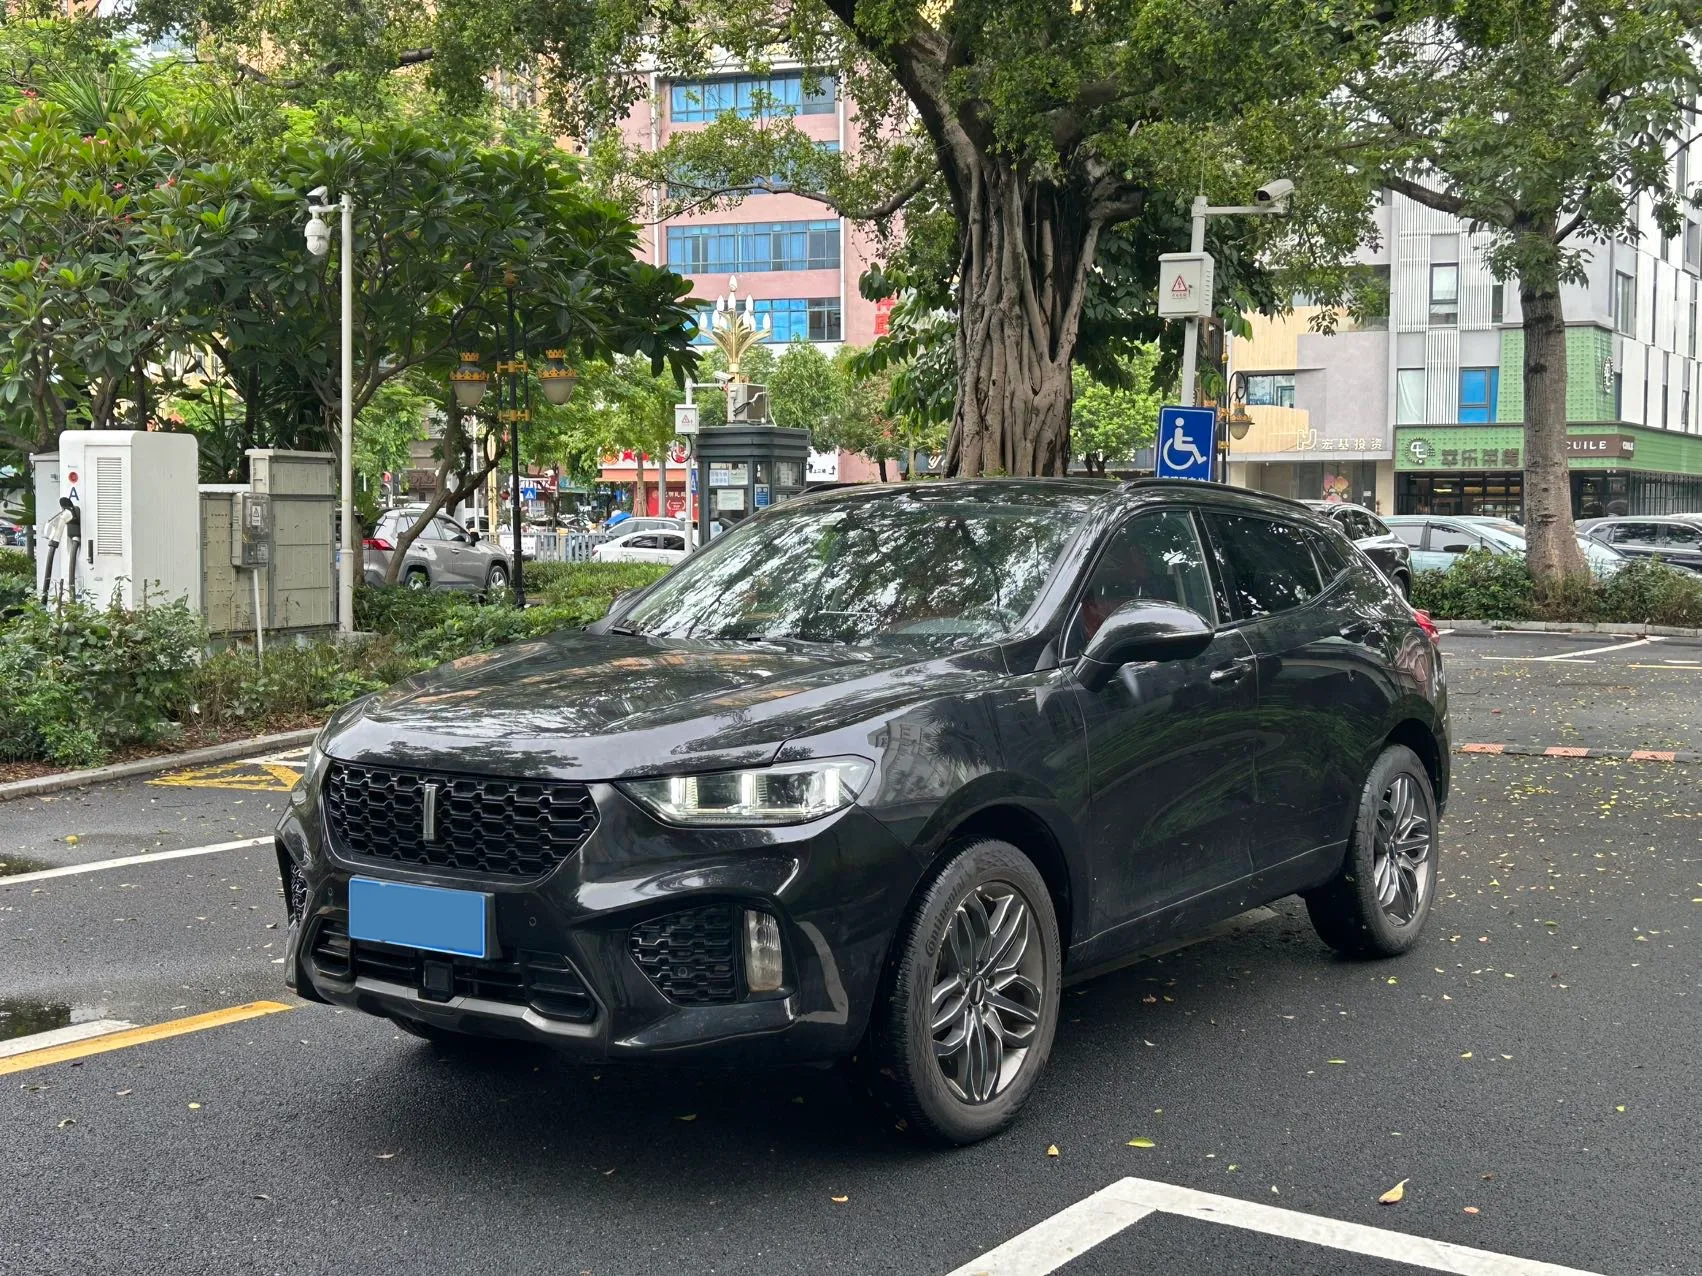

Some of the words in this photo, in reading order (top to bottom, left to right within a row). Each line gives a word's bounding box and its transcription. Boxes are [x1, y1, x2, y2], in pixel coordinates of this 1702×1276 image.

[1321, 438, 1383, 450] 宏基投资
[69, 486, 79, 501] A
[925, 878, 968, 958] Continental
